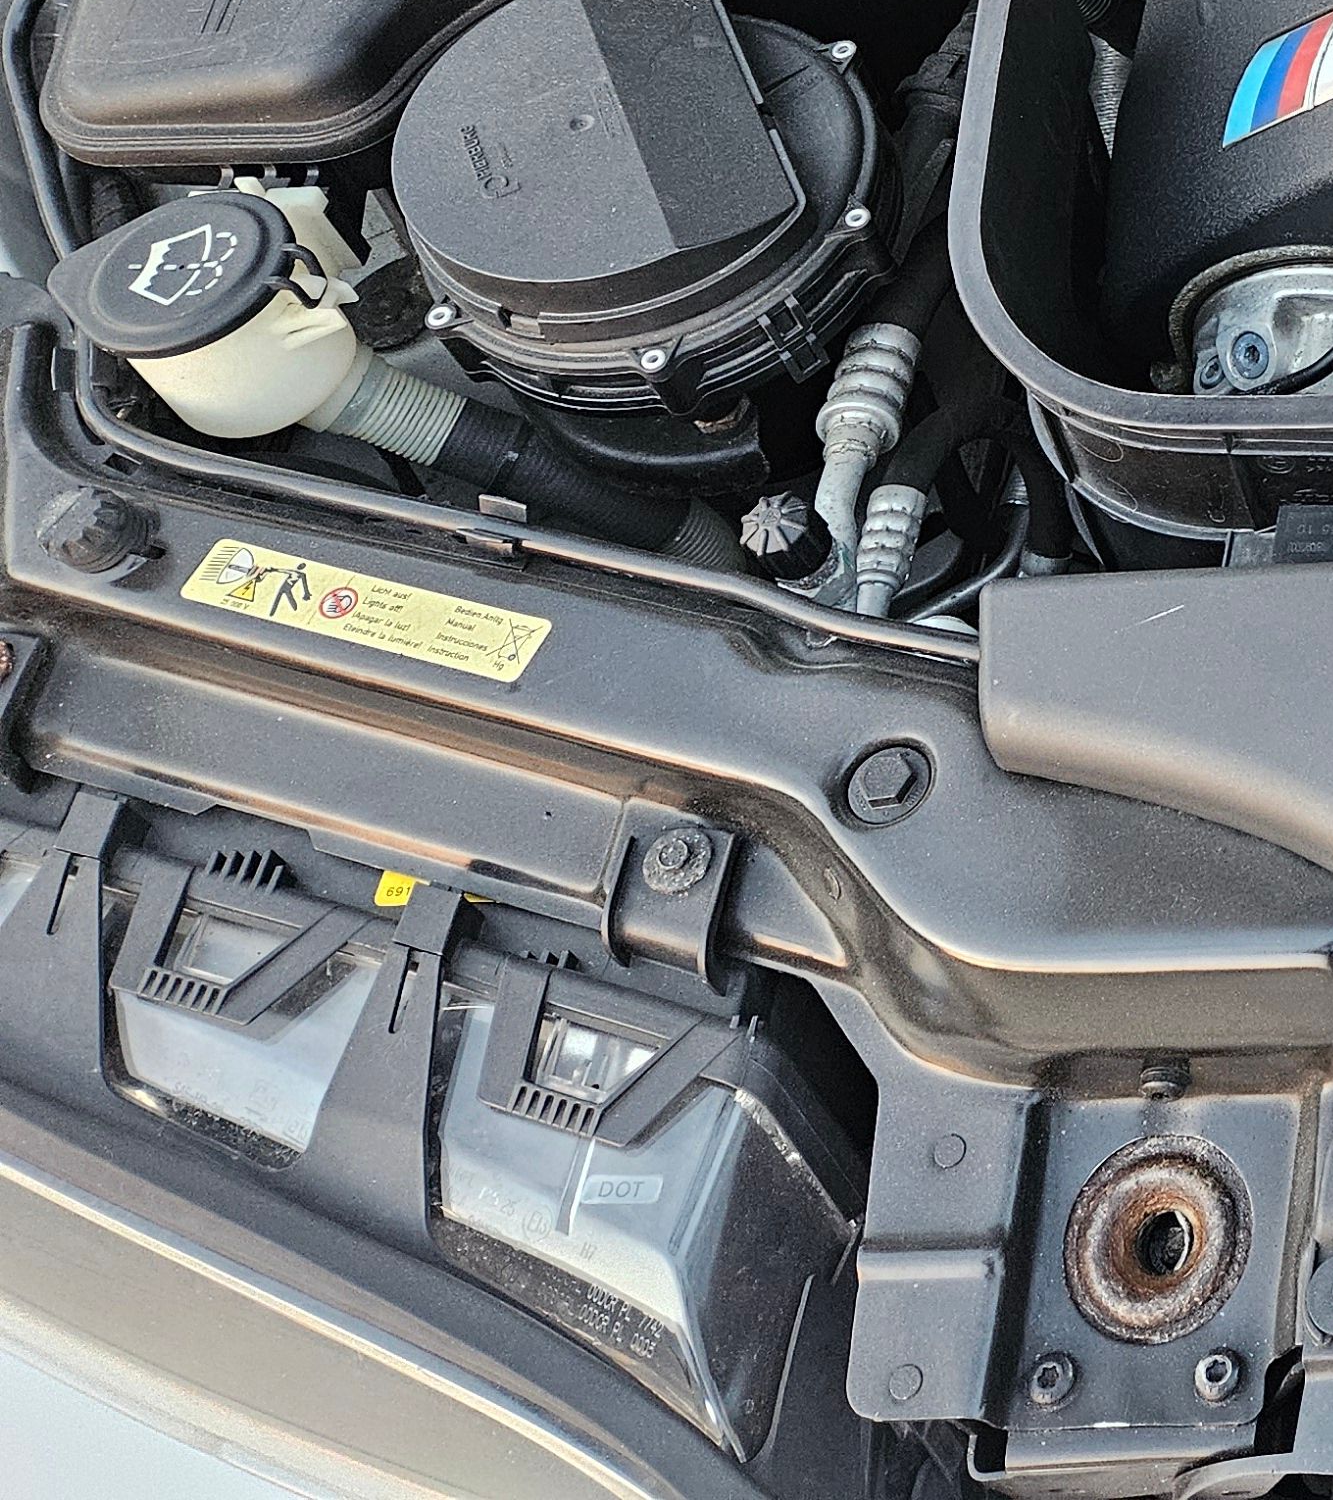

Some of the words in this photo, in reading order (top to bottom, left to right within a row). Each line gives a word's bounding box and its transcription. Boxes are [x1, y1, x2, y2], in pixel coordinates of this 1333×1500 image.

[371, 584, 392, 597] Licht
[393, 591, 413, 601] aus!
[362, 596, 388, 610] Lights
[384, 618, 393, 627] la
[445, 617, 477, 632] Manual
[435, 631, 488, 652] Instrucciones
[427, 644, 470, 662] Instruction
[492, 660, 505, 671] Hg
[386, 886, 411, 897] 691
[598, 1180, 645, 1199] DOT
